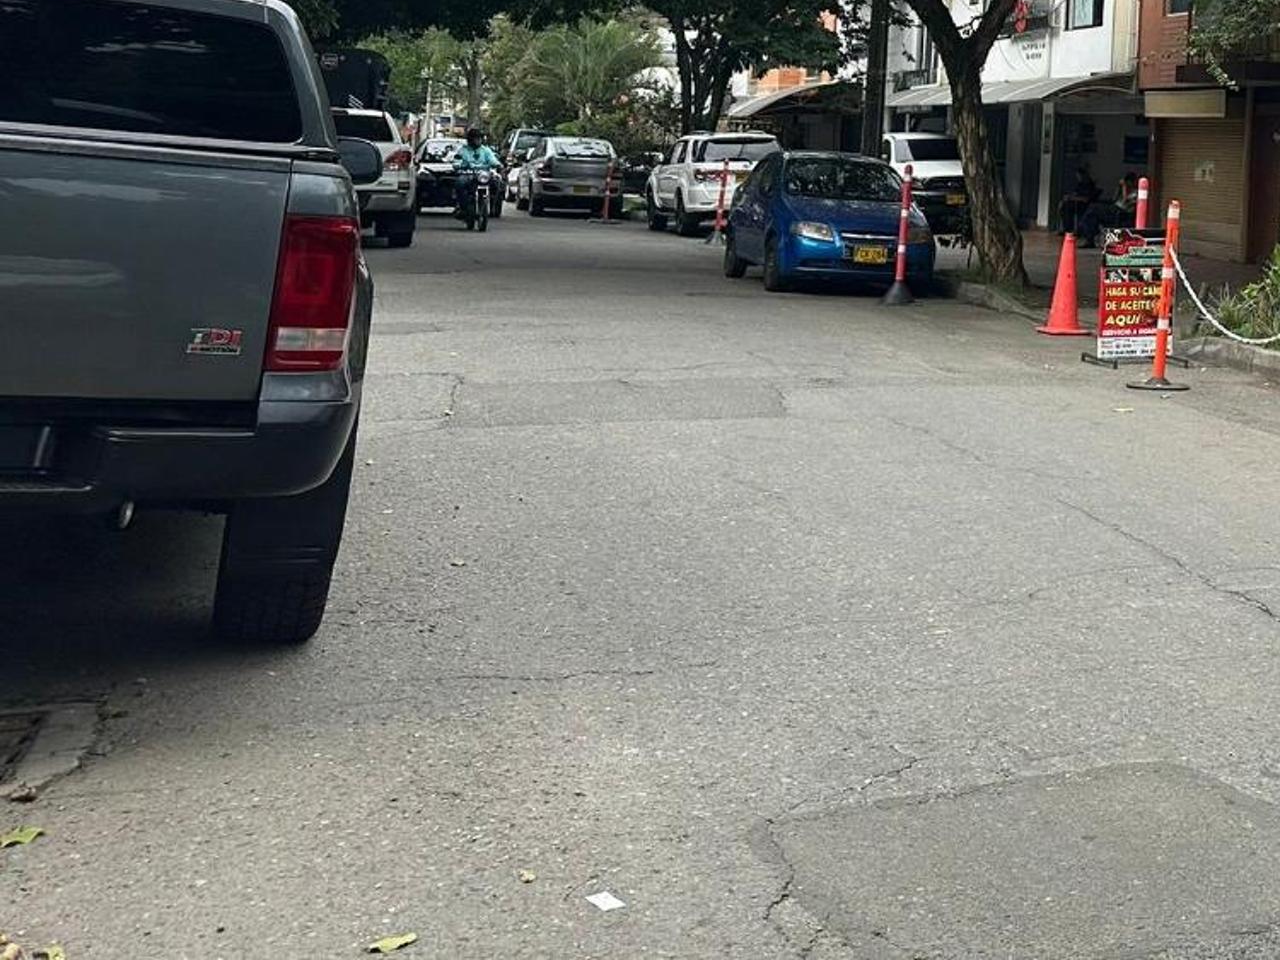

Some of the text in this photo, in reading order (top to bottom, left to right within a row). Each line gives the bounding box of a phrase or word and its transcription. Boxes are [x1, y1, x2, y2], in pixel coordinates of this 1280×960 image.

[1105, 286, 1127, 296] HAGA
[1129, 286, 1141, 296] SU
[1105, 300, 1151, 311] DE ACEITE
[191, 328, 242, 345] TDI
